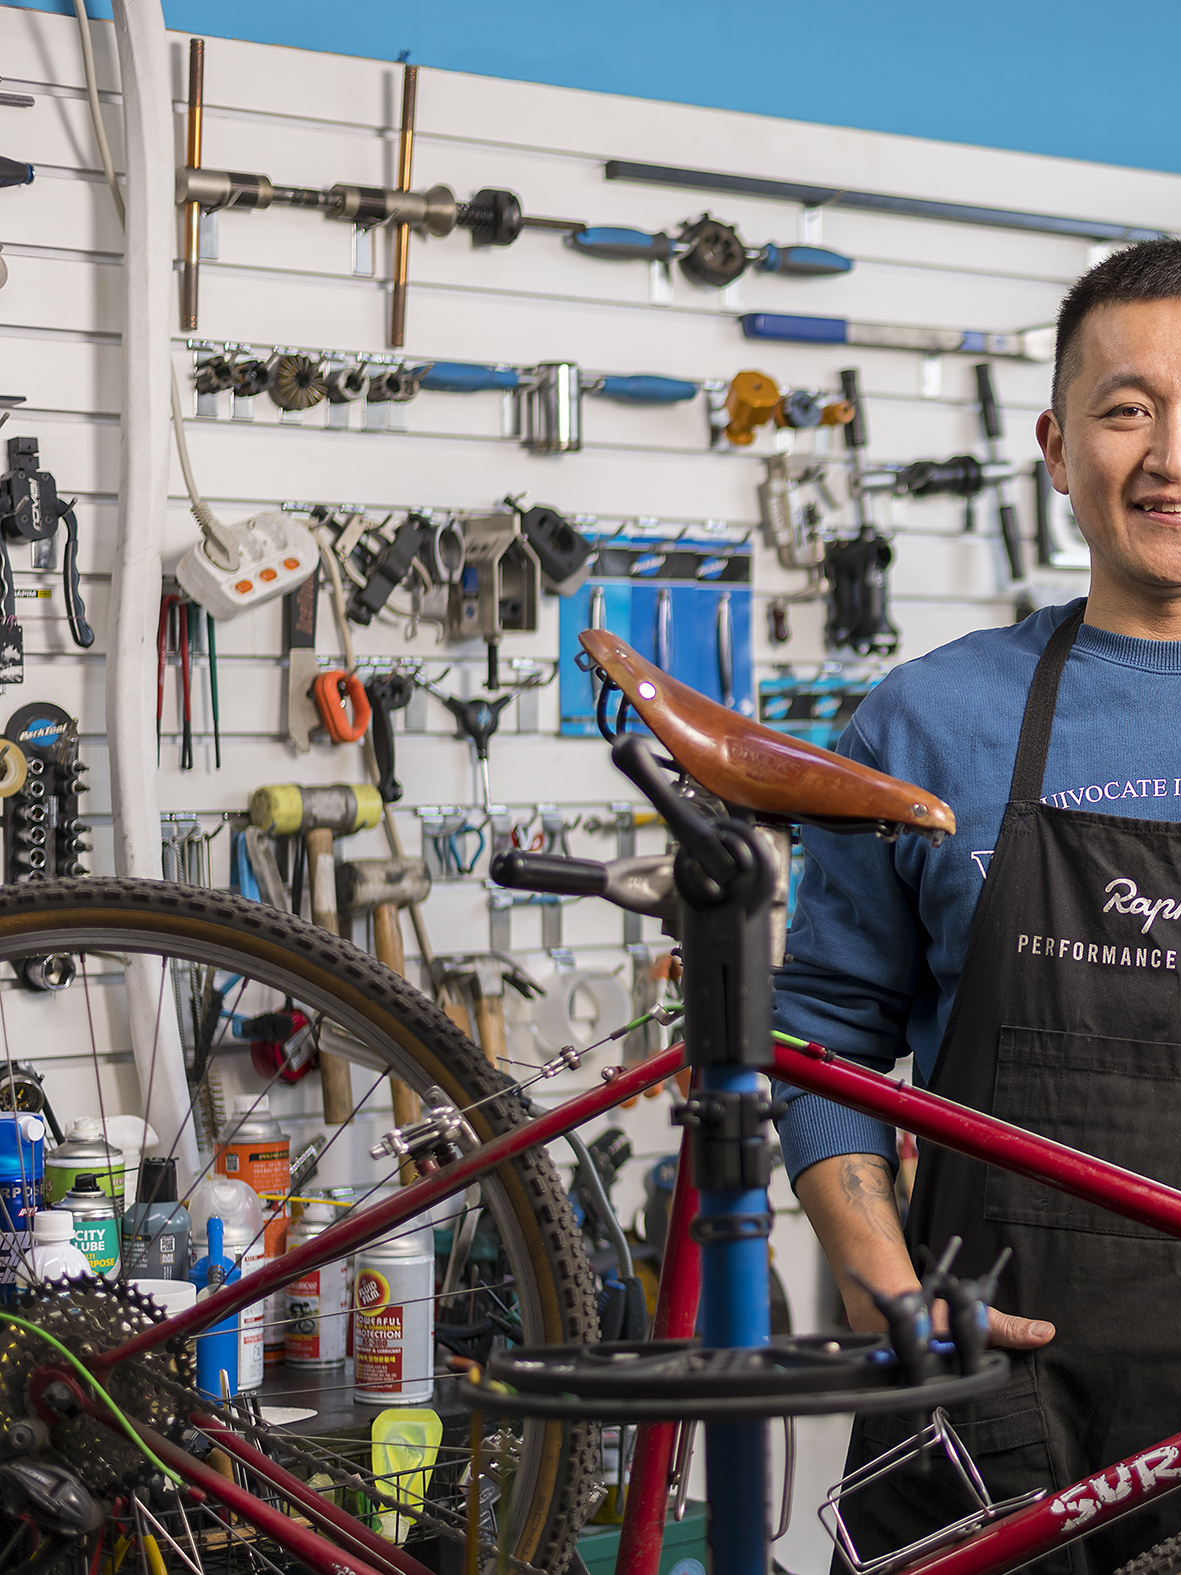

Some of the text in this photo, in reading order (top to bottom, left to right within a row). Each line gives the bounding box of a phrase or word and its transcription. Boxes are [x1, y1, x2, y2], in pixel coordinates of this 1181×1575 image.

[1018, 934, 1177, 970] PERFORMANCE
[75, 1229, 105, 1241] CITY
[359, 1280, 377, 1298] FLUID
[362, 1290, 380, 1305] FILM
[355, 1327, 401, 1339] PROTECTION
